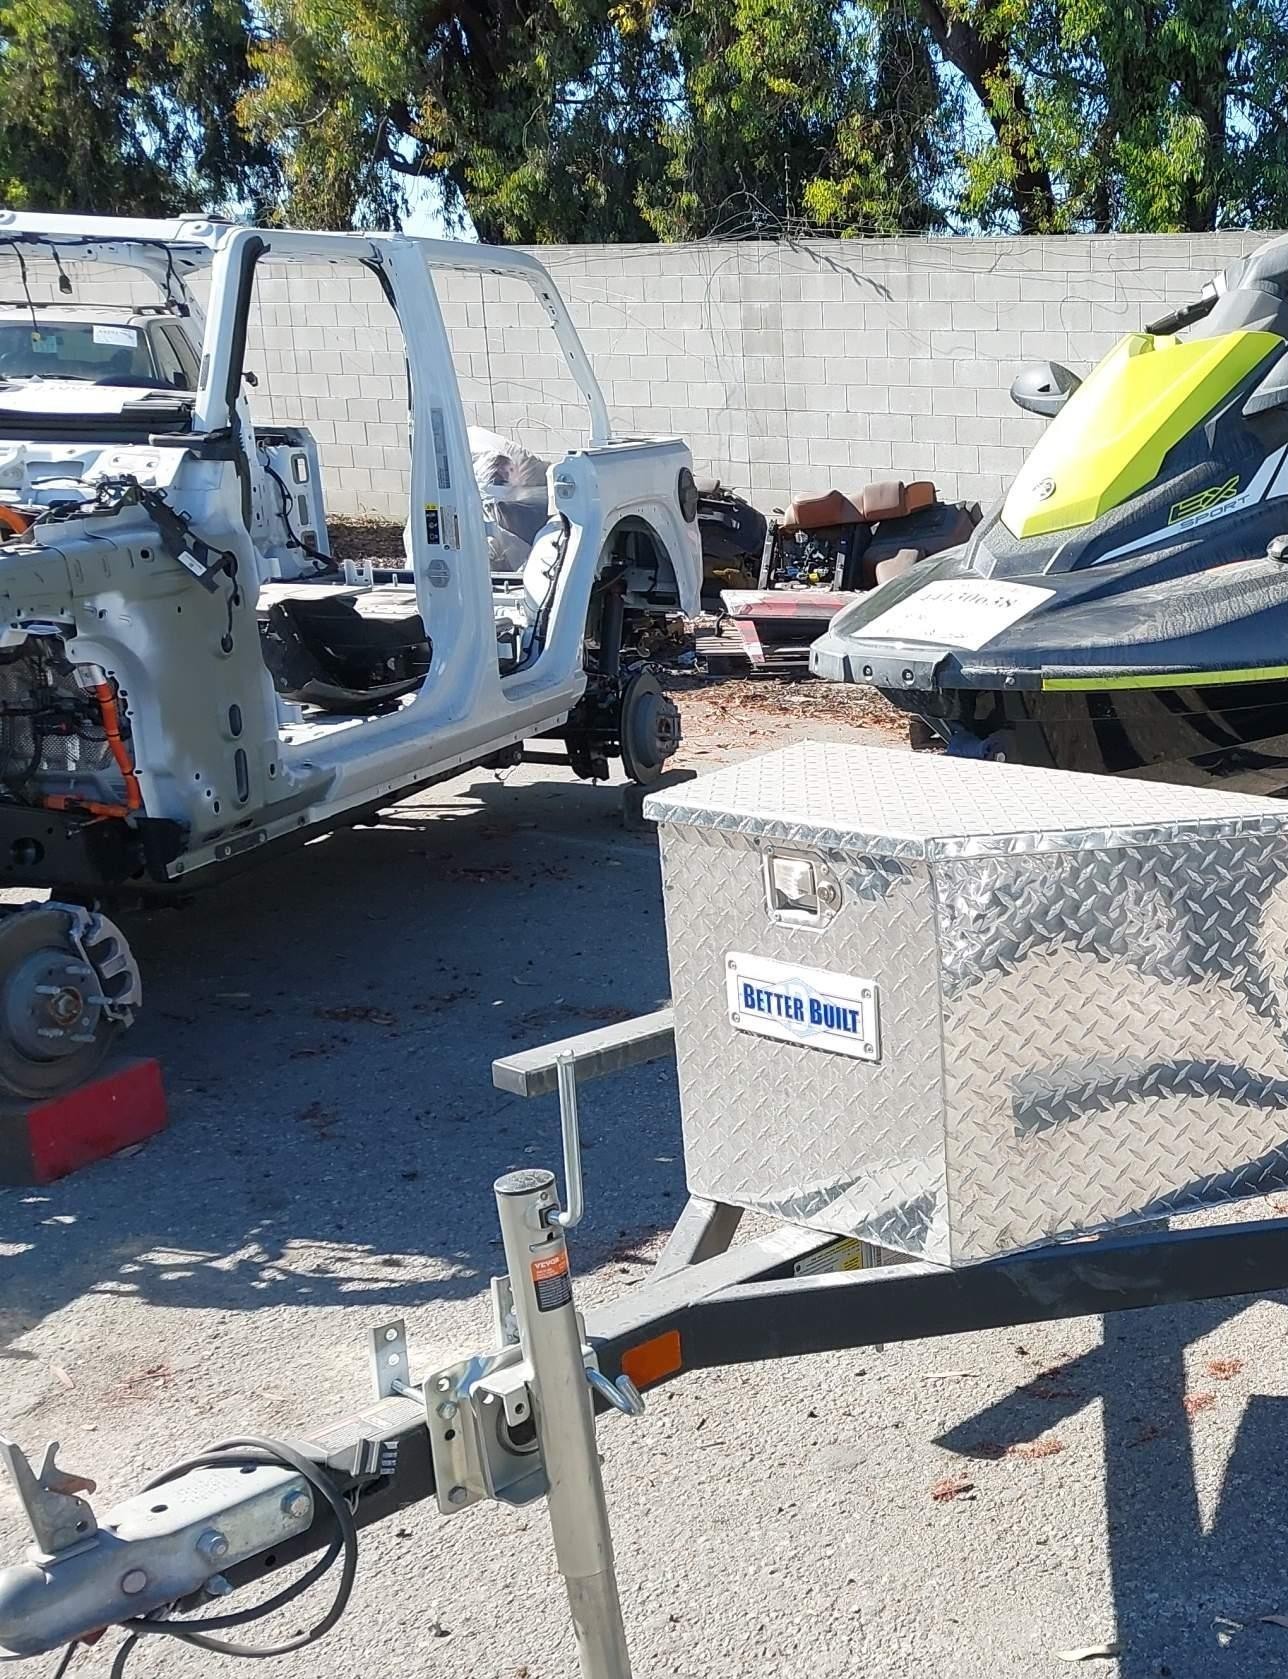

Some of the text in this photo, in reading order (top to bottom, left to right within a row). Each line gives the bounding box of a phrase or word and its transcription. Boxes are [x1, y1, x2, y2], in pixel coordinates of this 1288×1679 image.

[1168, 475, 1240, 526] EX
[1180, 494, 1250, 530] SPORT
[743, 982, 860, 1034] BETTER BUILT
